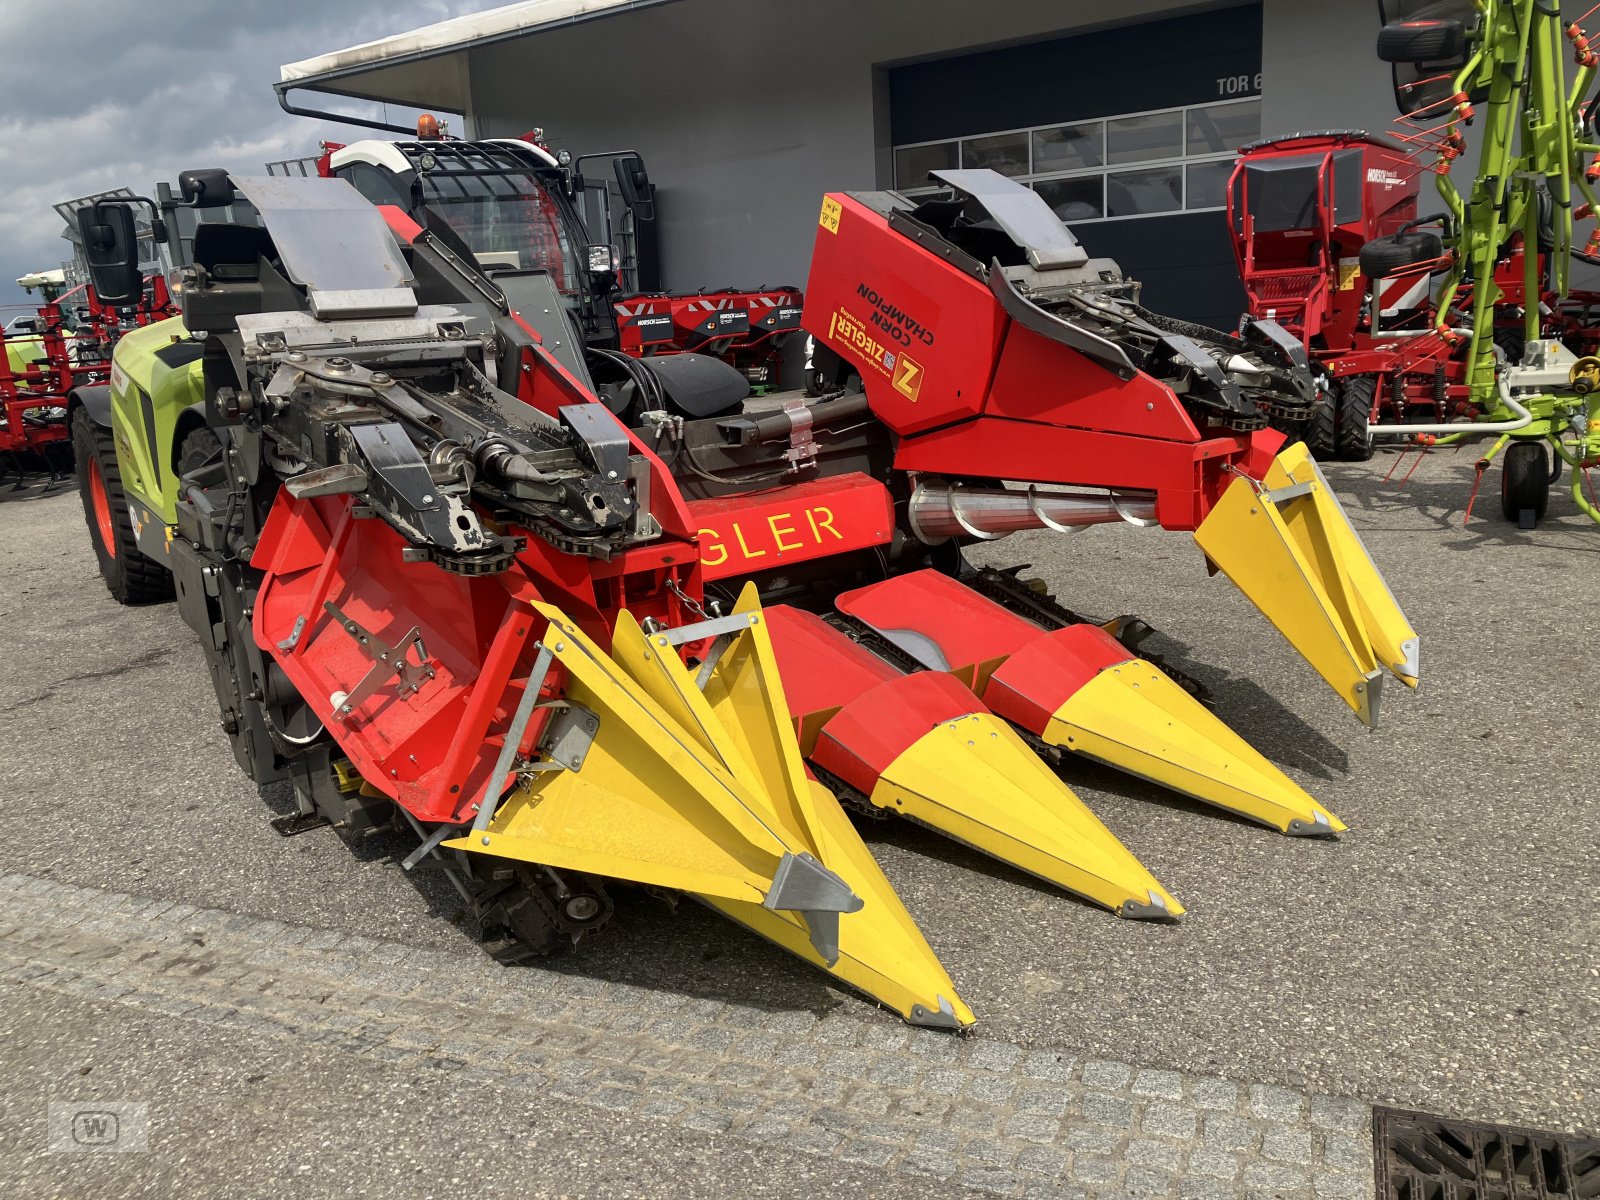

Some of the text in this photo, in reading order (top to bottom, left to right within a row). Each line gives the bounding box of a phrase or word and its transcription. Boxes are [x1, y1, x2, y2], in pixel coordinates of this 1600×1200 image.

[1216, 75, 1249, 95] TOR
[637, 318, 656, 326] HORSCH
[840, 306, 866, 331] Harvesting
[857, 283, 934, 346] CHAMPION
[870, 311, 911, 347] CORN
[837, 315, 886, 363] ZIEGLER
[693, 506, 844, 566] GLER
